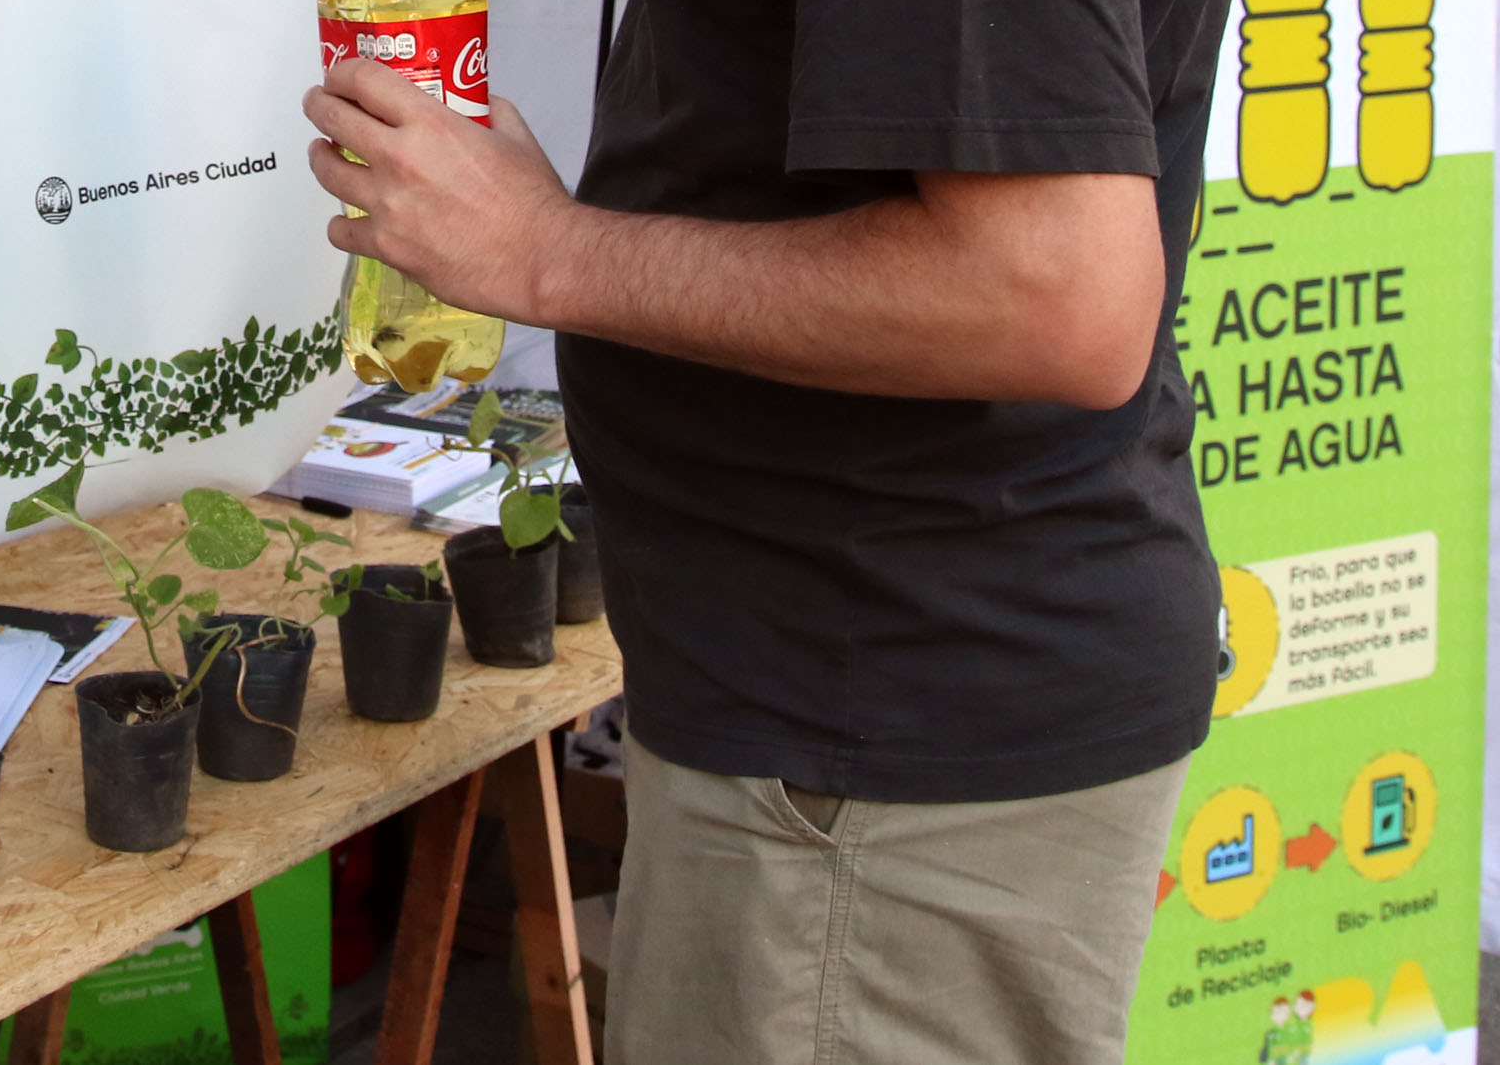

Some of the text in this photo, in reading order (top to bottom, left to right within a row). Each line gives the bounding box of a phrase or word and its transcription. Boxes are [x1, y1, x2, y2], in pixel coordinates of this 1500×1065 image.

[78, 152, 277, 204] Buenos Aires Ciudad
[1212, 268, 1404, 347] ACEITE
[1239, 343, 1404, 416] HASTA
[1201, 413, 1403, 488] DE AGUA
[1335, 556, 1380, 581] para
[1385, 548, 1417, 571] que
[1289, 572, 1426, 612] la botella no se
[1289, 602, 1411, 640] deforme y su
[1288, 625, 1428, 667] transporte sea
[1287, 672, 1326, 694] más
[1380, 890, 1439, 923] Diesel
[1196, 937, 1266, 968] Planta
[1167, 960, 1293, 1009] de Reciclaje
